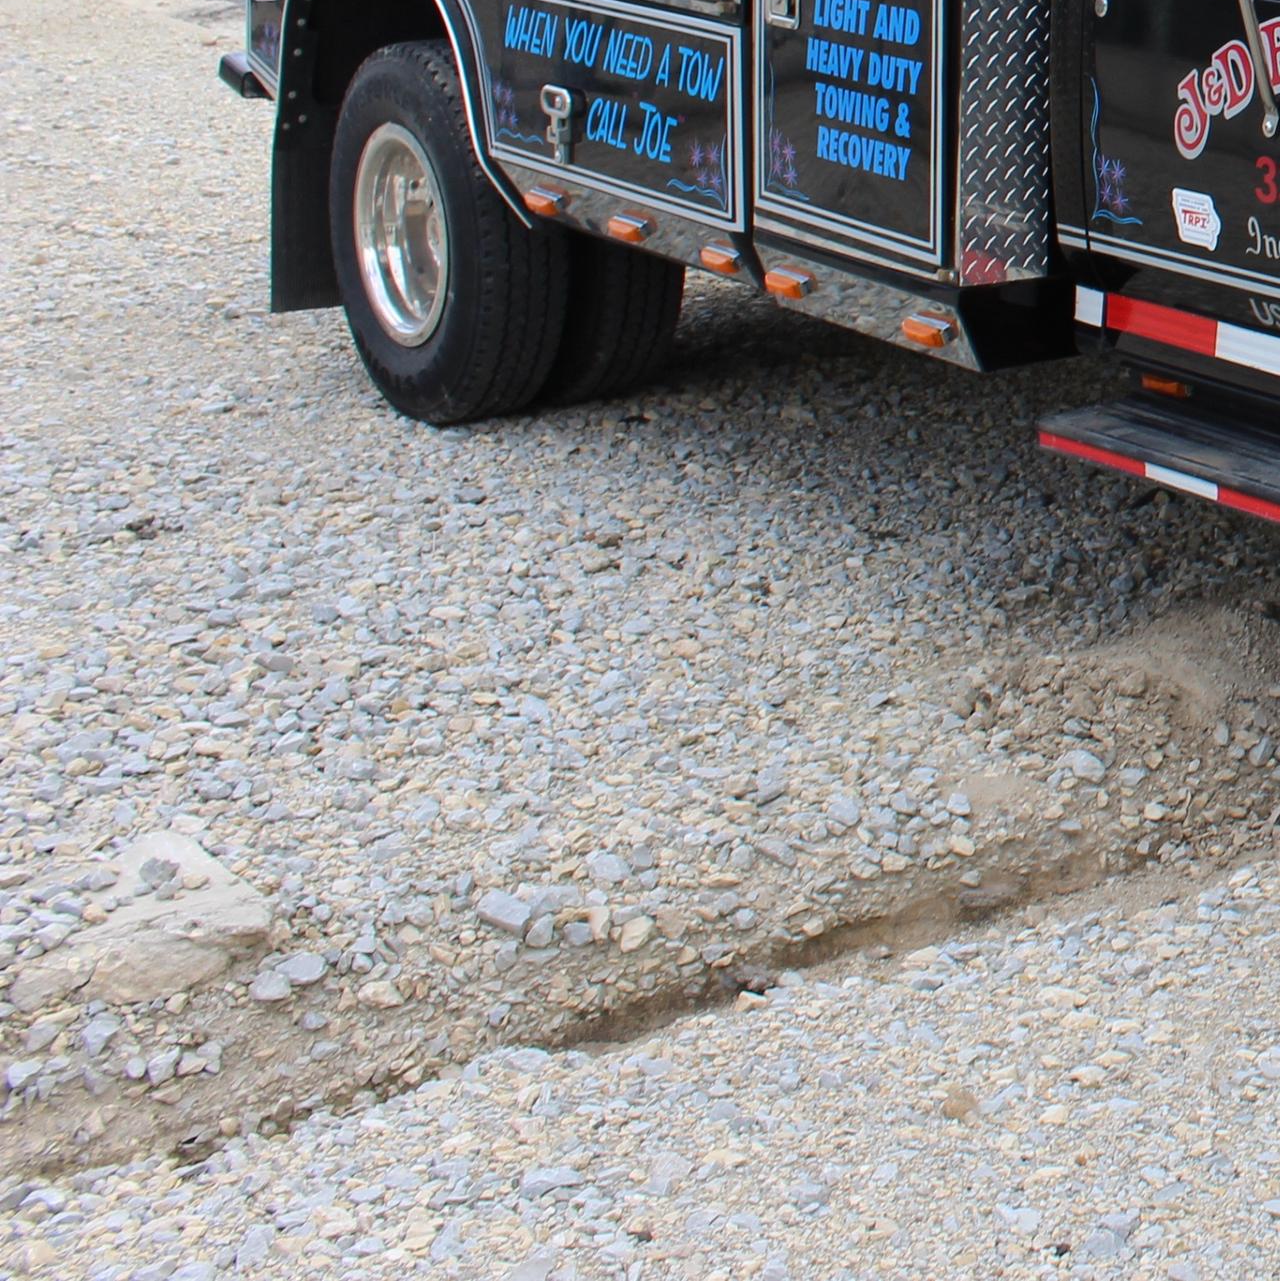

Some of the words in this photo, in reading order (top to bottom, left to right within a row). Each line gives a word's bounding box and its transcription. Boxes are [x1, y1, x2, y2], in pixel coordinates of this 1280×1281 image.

[504, 4, 558, 58] WHEN
[563, 16, 603, 67] YOU
[603, 28, 653, 80] NEED
[656, 43, 671, 88] A
[678, 46, 724, 102] TOW
[873, 4, 920, 45] AND
[806, 37, 864, 81] HEAVY
[867, 52, 922, 95] DUTY
[815, 82, 890, 132] TOWING
[895, 103, 911, 138] &
[1174, 39, 1255, 160] J&D
[586, 98, 627, 149] CALL
[634, 101, 678, 164] JOE
[817, 125, 911, 181] RECOVERY
